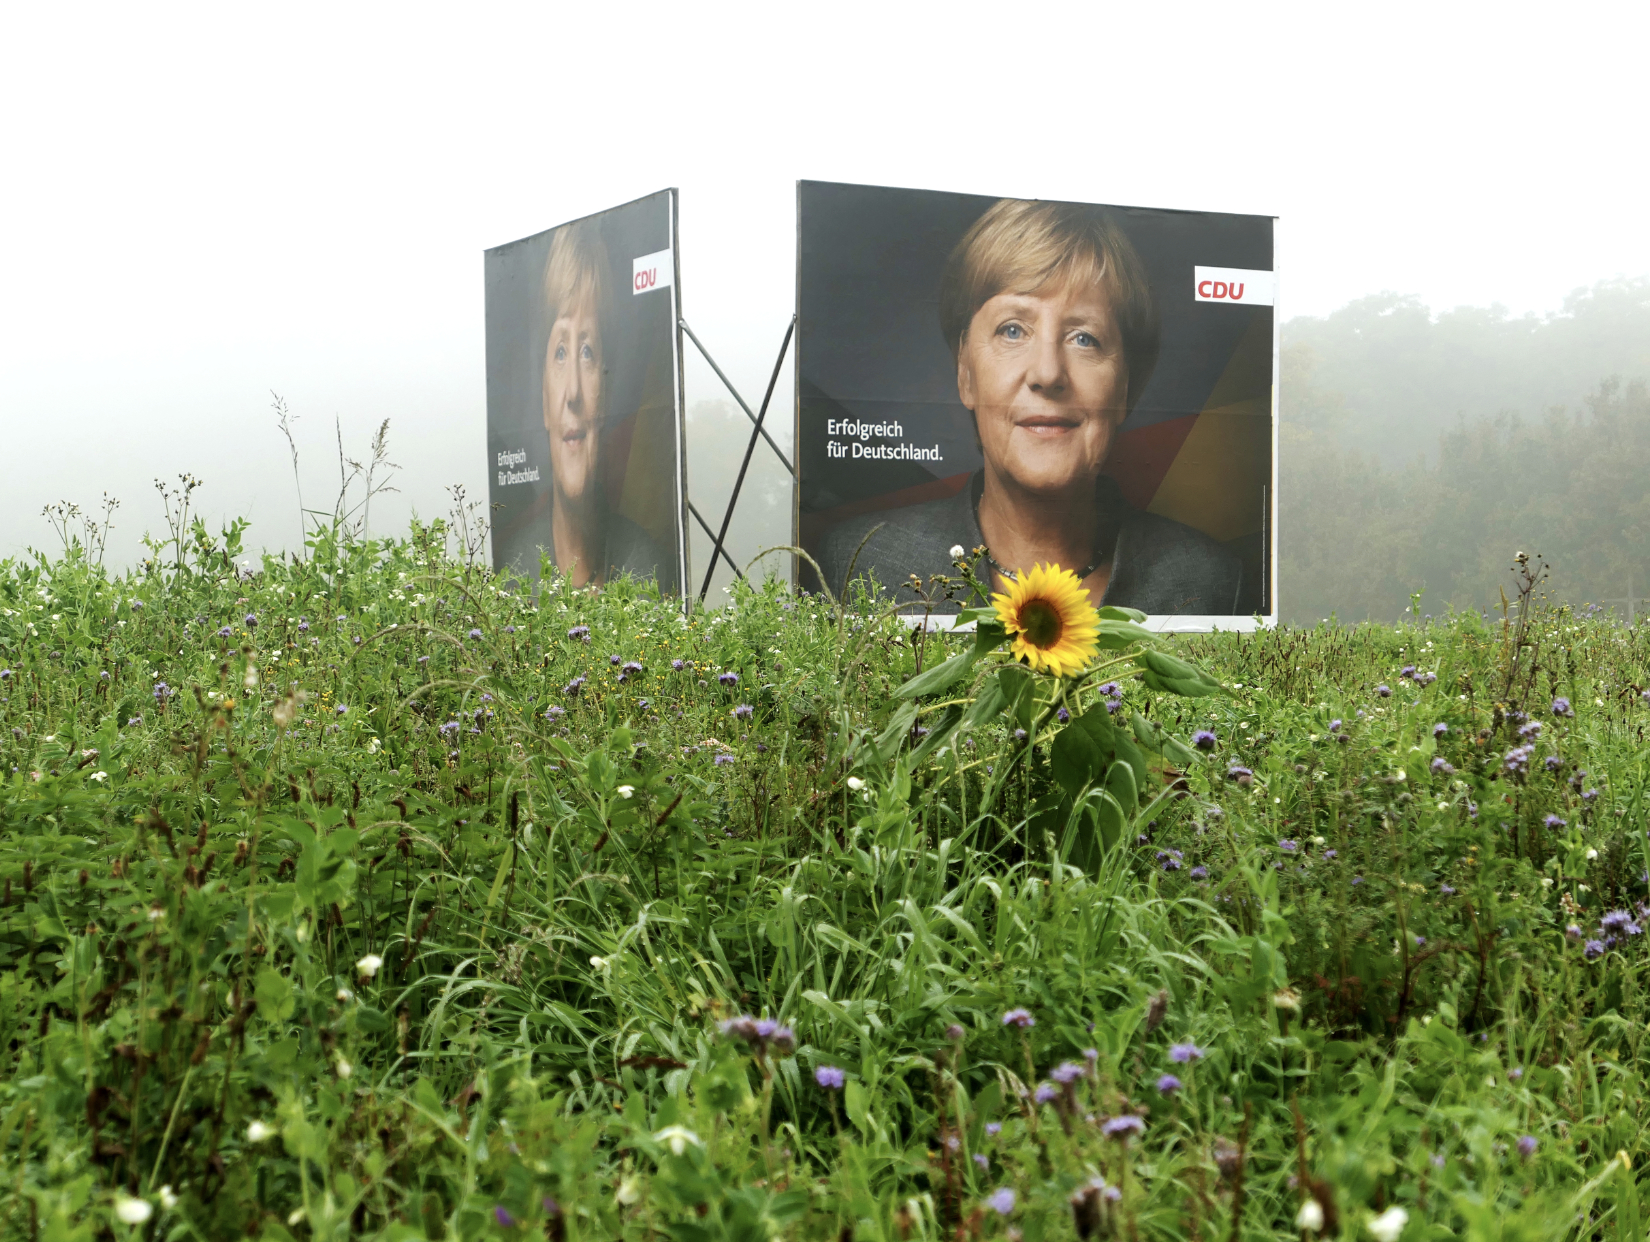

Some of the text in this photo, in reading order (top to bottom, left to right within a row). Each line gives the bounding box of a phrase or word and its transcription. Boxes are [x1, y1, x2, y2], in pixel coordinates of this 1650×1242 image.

[634, 267, 657, 290] CDU
[1198, 280, 1244, 300] CDU
[827, 418, 903, 441] Erfolgreich
[498, 448, 526, 469] Erfolgreich
[827, 441, 943, 461] für Deutschland.
[498, 466, 540, 486] für Deutschland.
